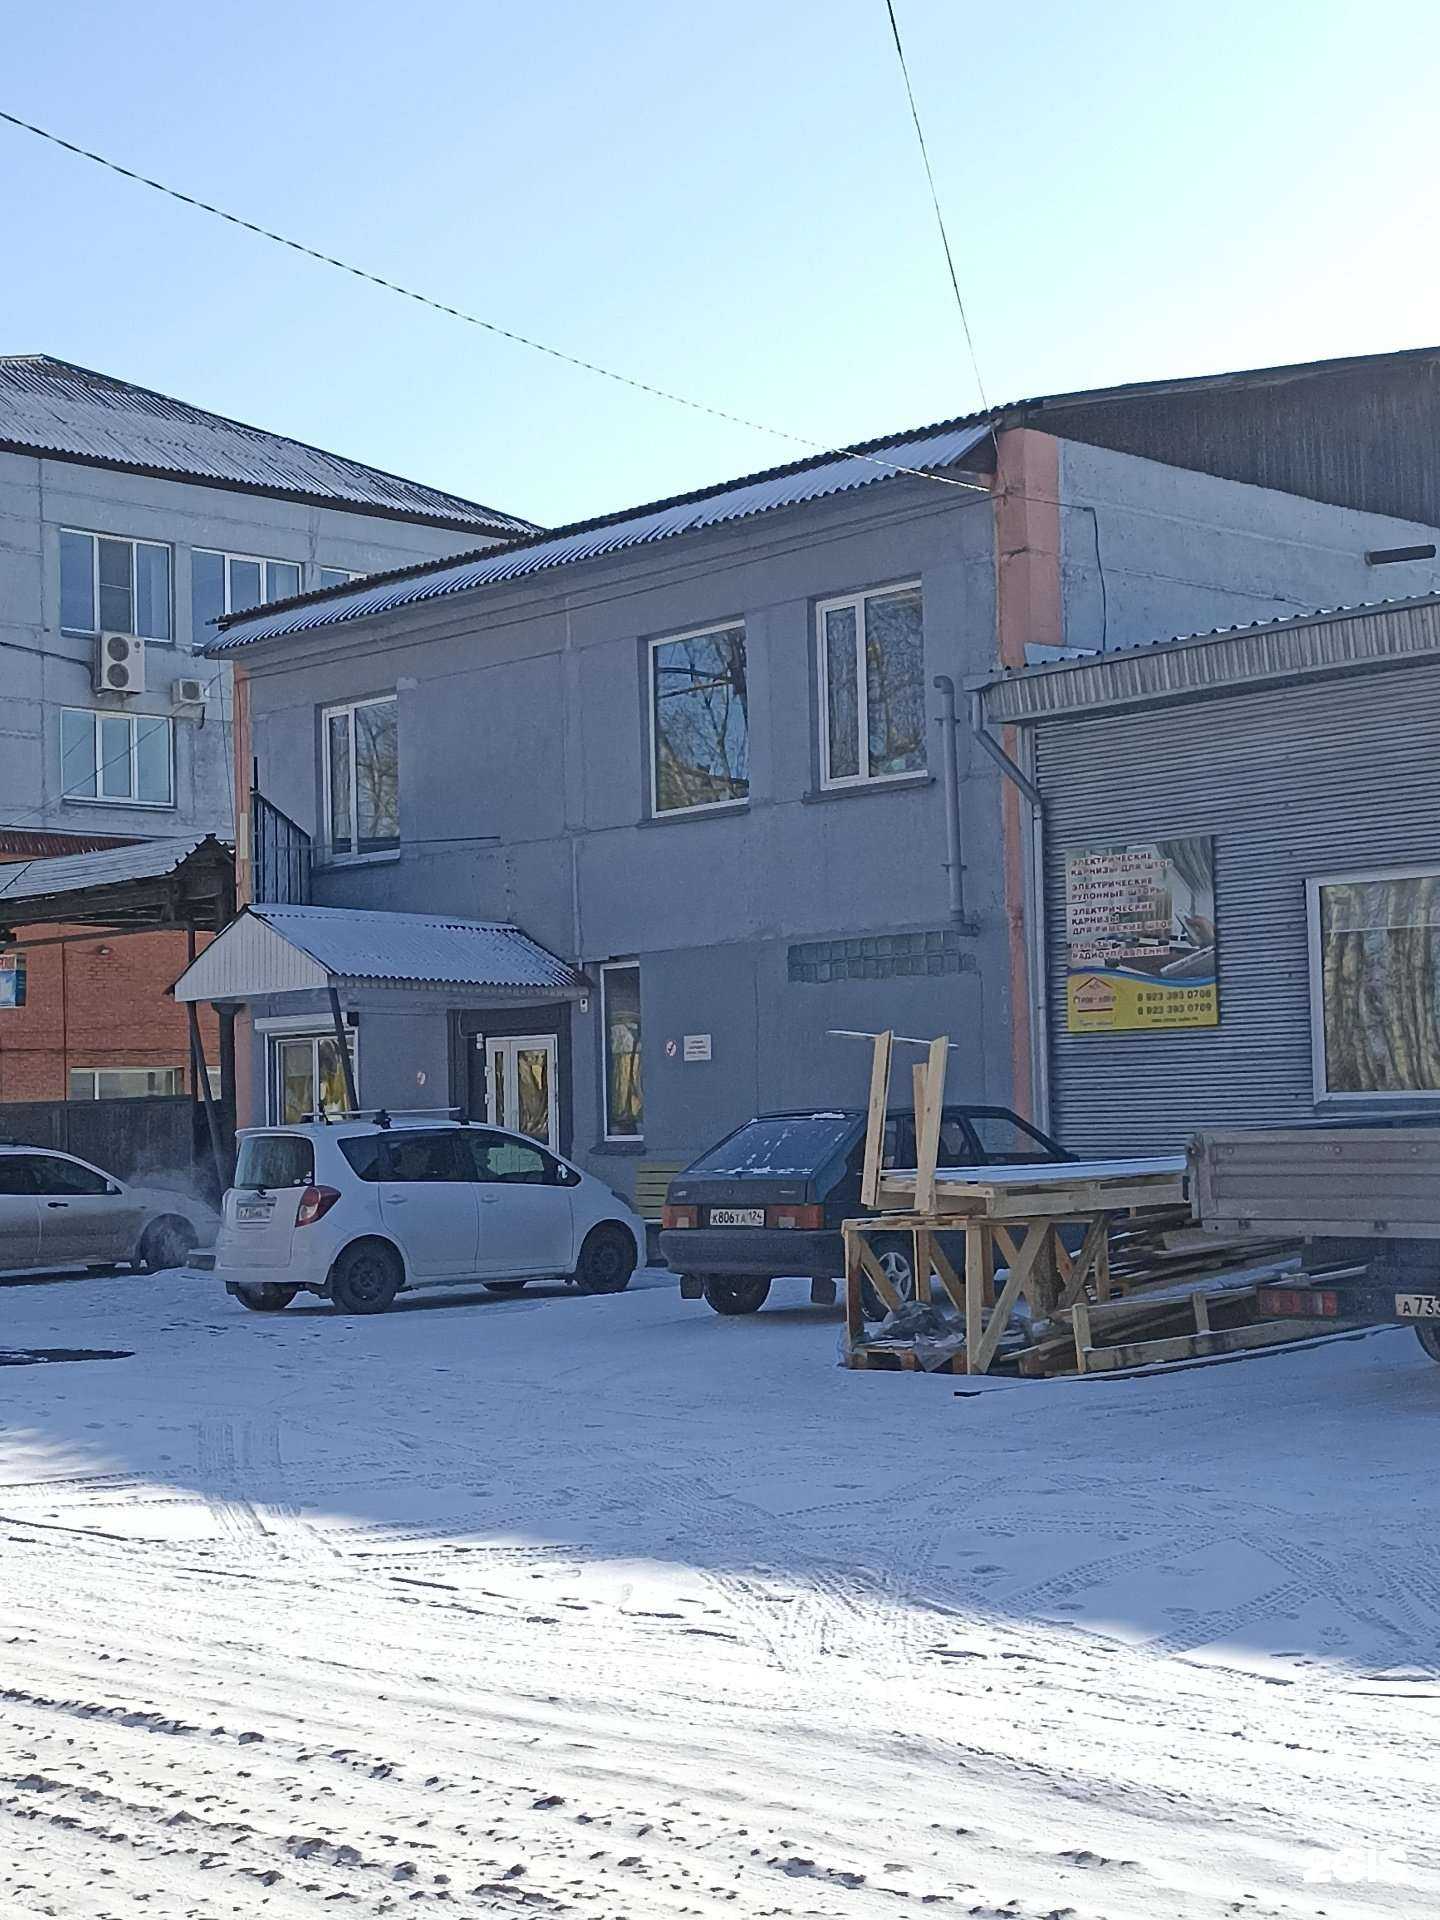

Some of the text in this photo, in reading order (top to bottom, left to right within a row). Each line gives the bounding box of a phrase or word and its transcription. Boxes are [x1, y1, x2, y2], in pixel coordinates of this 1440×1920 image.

[1072, 853, 1152, 866] ЭЛЕКТРИЧЕСКИЕ
[1071, 867, 1118, 876] КАРНИЗЫ
[1121, 864, 1141, 872] ДЛЯ
[1072, 877, 1152, 891] ЭЛЕКТРИЧЕСКИЕ
[1071, 889, 1123, 901] РУЛОННЫЕ
[1073, 903, 1153, 916] ЭЛЕКТРИЧЕСКИЕ
[1071, 916, 1120, 925] КАРНИЗЫ
[1072, 926, 1092, 935] ДЛЯ
